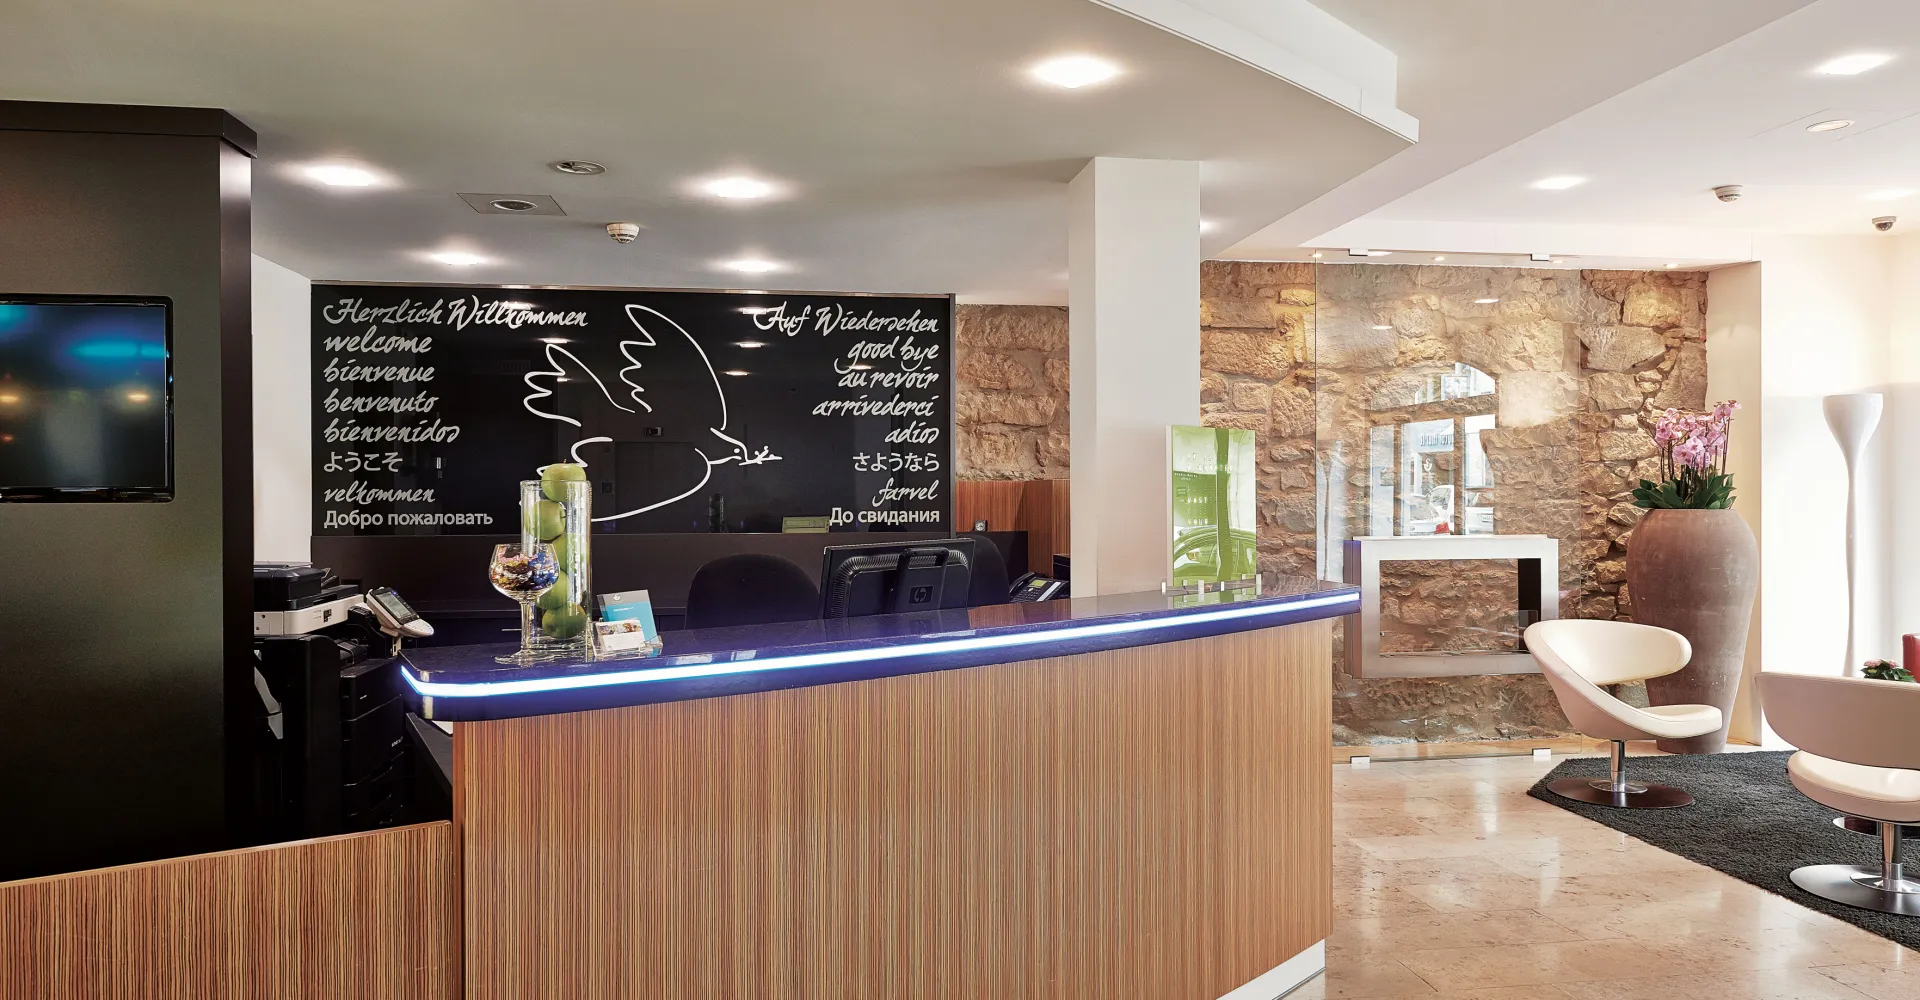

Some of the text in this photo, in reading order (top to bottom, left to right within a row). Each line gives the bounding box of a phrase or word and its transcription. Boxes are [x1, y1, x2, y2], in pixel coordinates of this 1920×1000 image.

[323, 295, 588, 330] Herzlich Willkommen
[752, 301, 939, 336] Auf Wiedersehen
[324, 325, 432, 353] welcome
[834, 335, 939, 374] good bye
[324, 357, 434, 382] bienvenue
[838, 366, 939, 389] au revoir
[324, 388, 439, 413] benvenuto
[812, 394, 939, 416] arrivederci
[324, 418, 460, 442] bienvenidos
[324, 452, 402, 472] ようこそ
[853, 452, 939, 472] さようなら
[324, 480, 435, 504] velkommen
[872, 478, 939, 507] farvel
[324, 510, 493, 529] Добро пожаловать
[829, 507, 939, 526] До свидания
